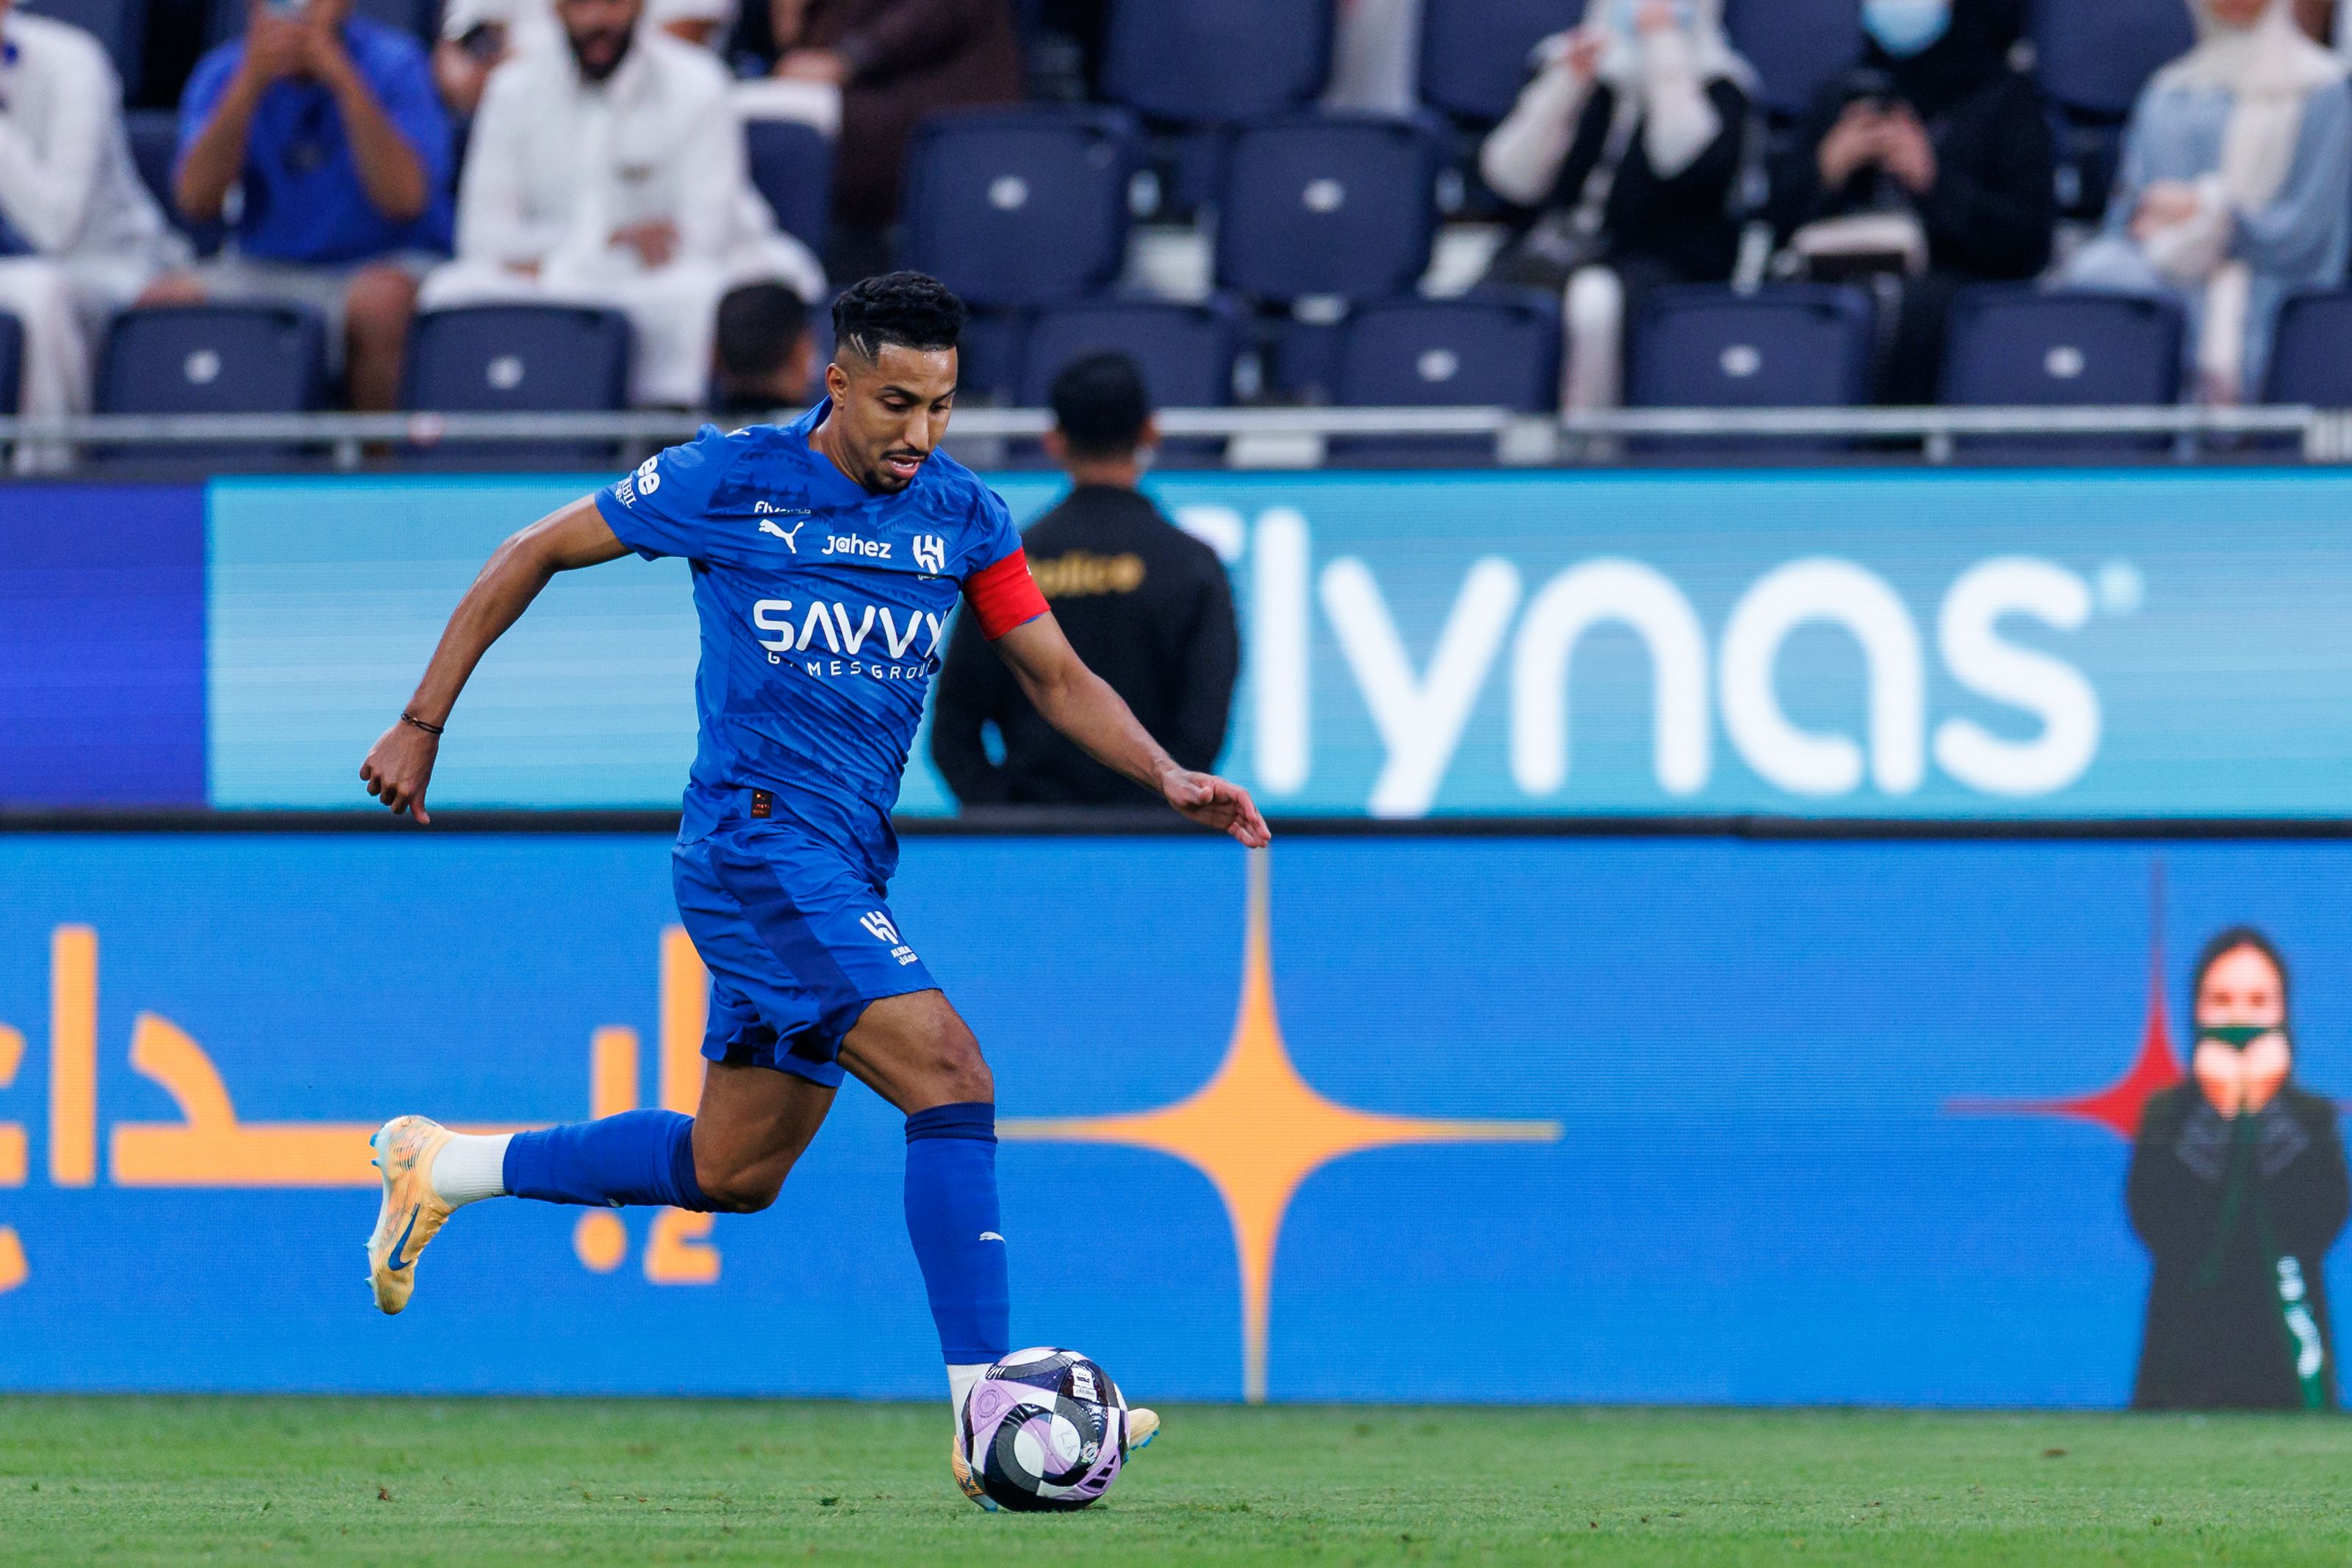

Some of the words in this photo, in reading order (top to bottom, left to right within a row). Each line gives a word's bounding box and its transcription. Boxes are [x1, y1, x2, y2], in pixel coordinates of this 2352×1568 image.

[753, 599, 947, 658] SAVVY
[767, 651, 861, 677] GMES
[871, 658, 934, 679] GROU
[1177, 506, 2102, 819] lynas
[0, 924, 721, 1292] إبدا
